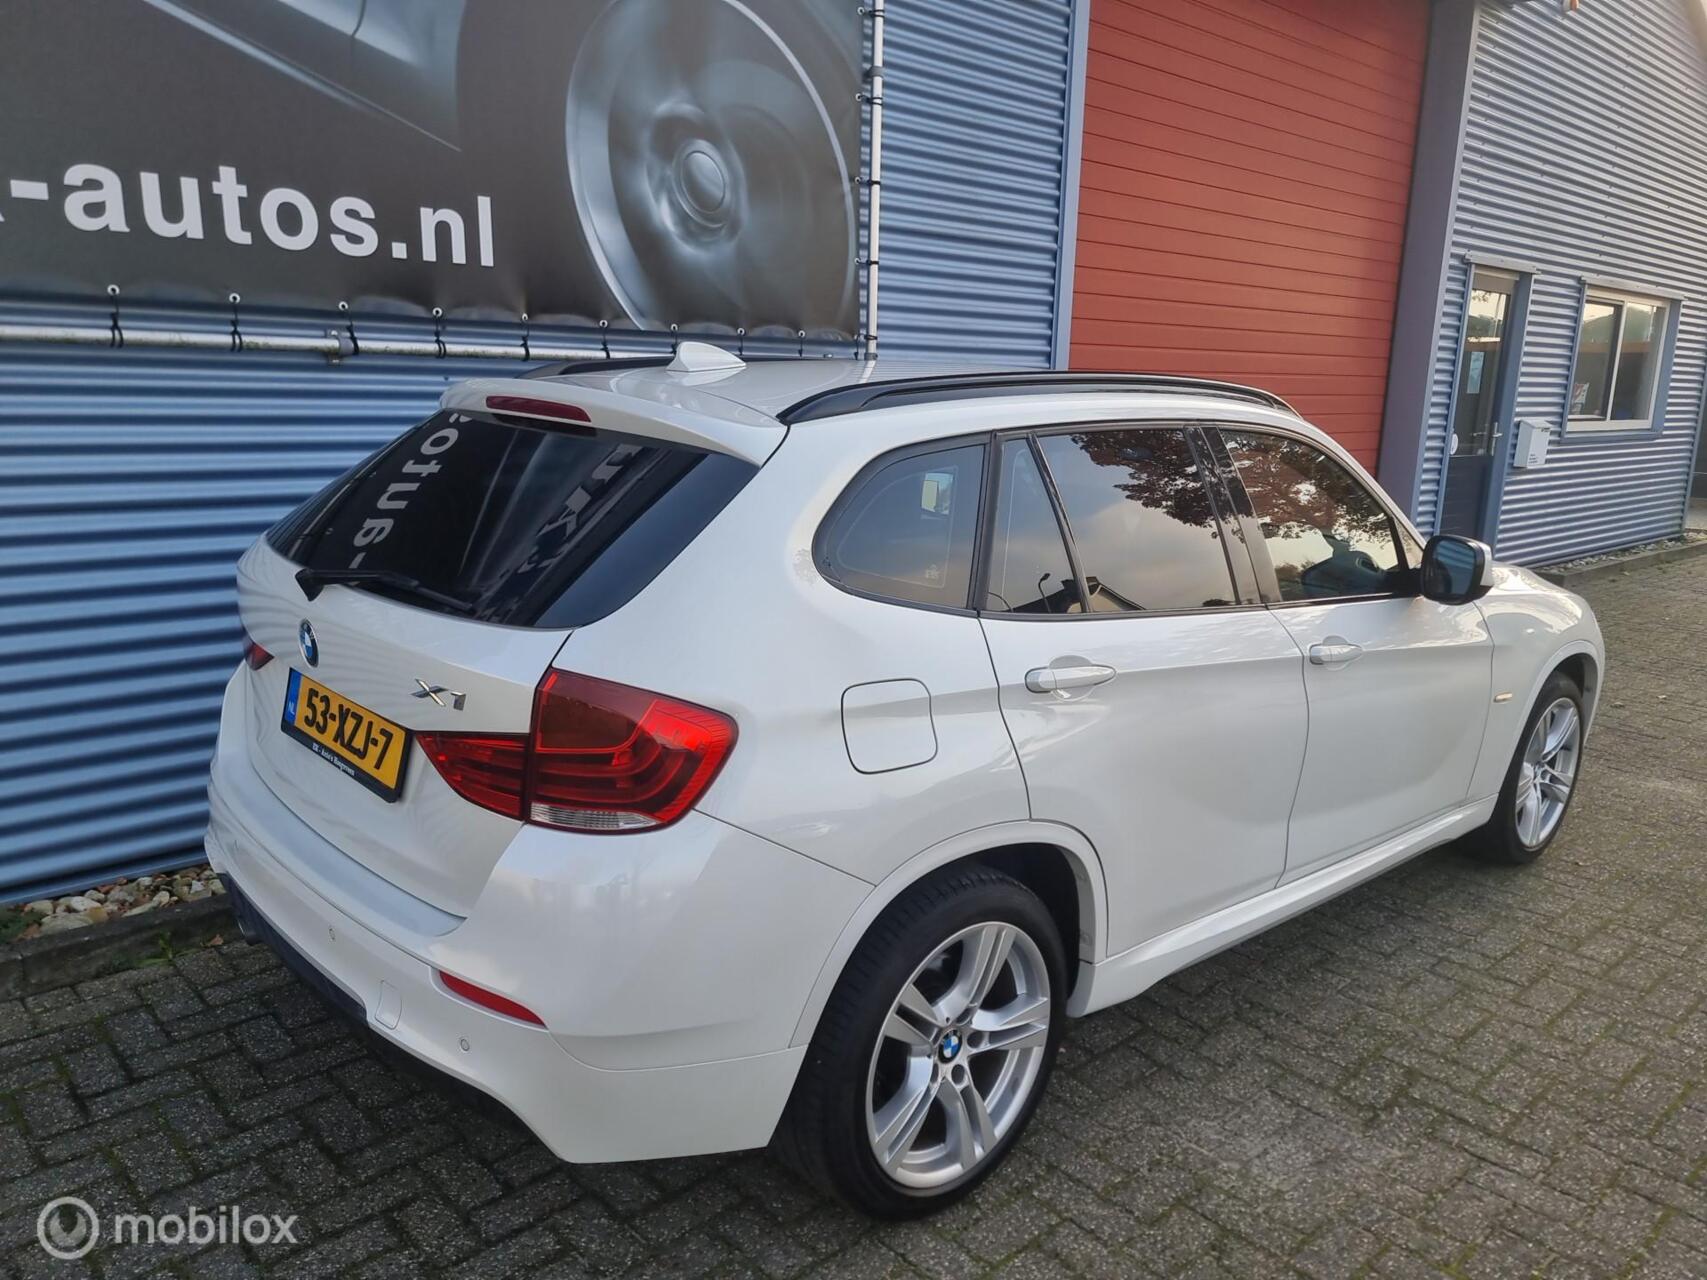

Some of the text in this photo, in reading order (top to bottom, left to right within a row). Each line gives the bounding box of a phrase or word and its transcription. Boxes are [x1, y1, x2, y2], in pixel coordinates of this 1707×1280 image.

[0, 163, 494, 267] -autos.nl
[304, 687, 394, 770] 53-XZJ-7
[410, 678, 467, 711] X1
